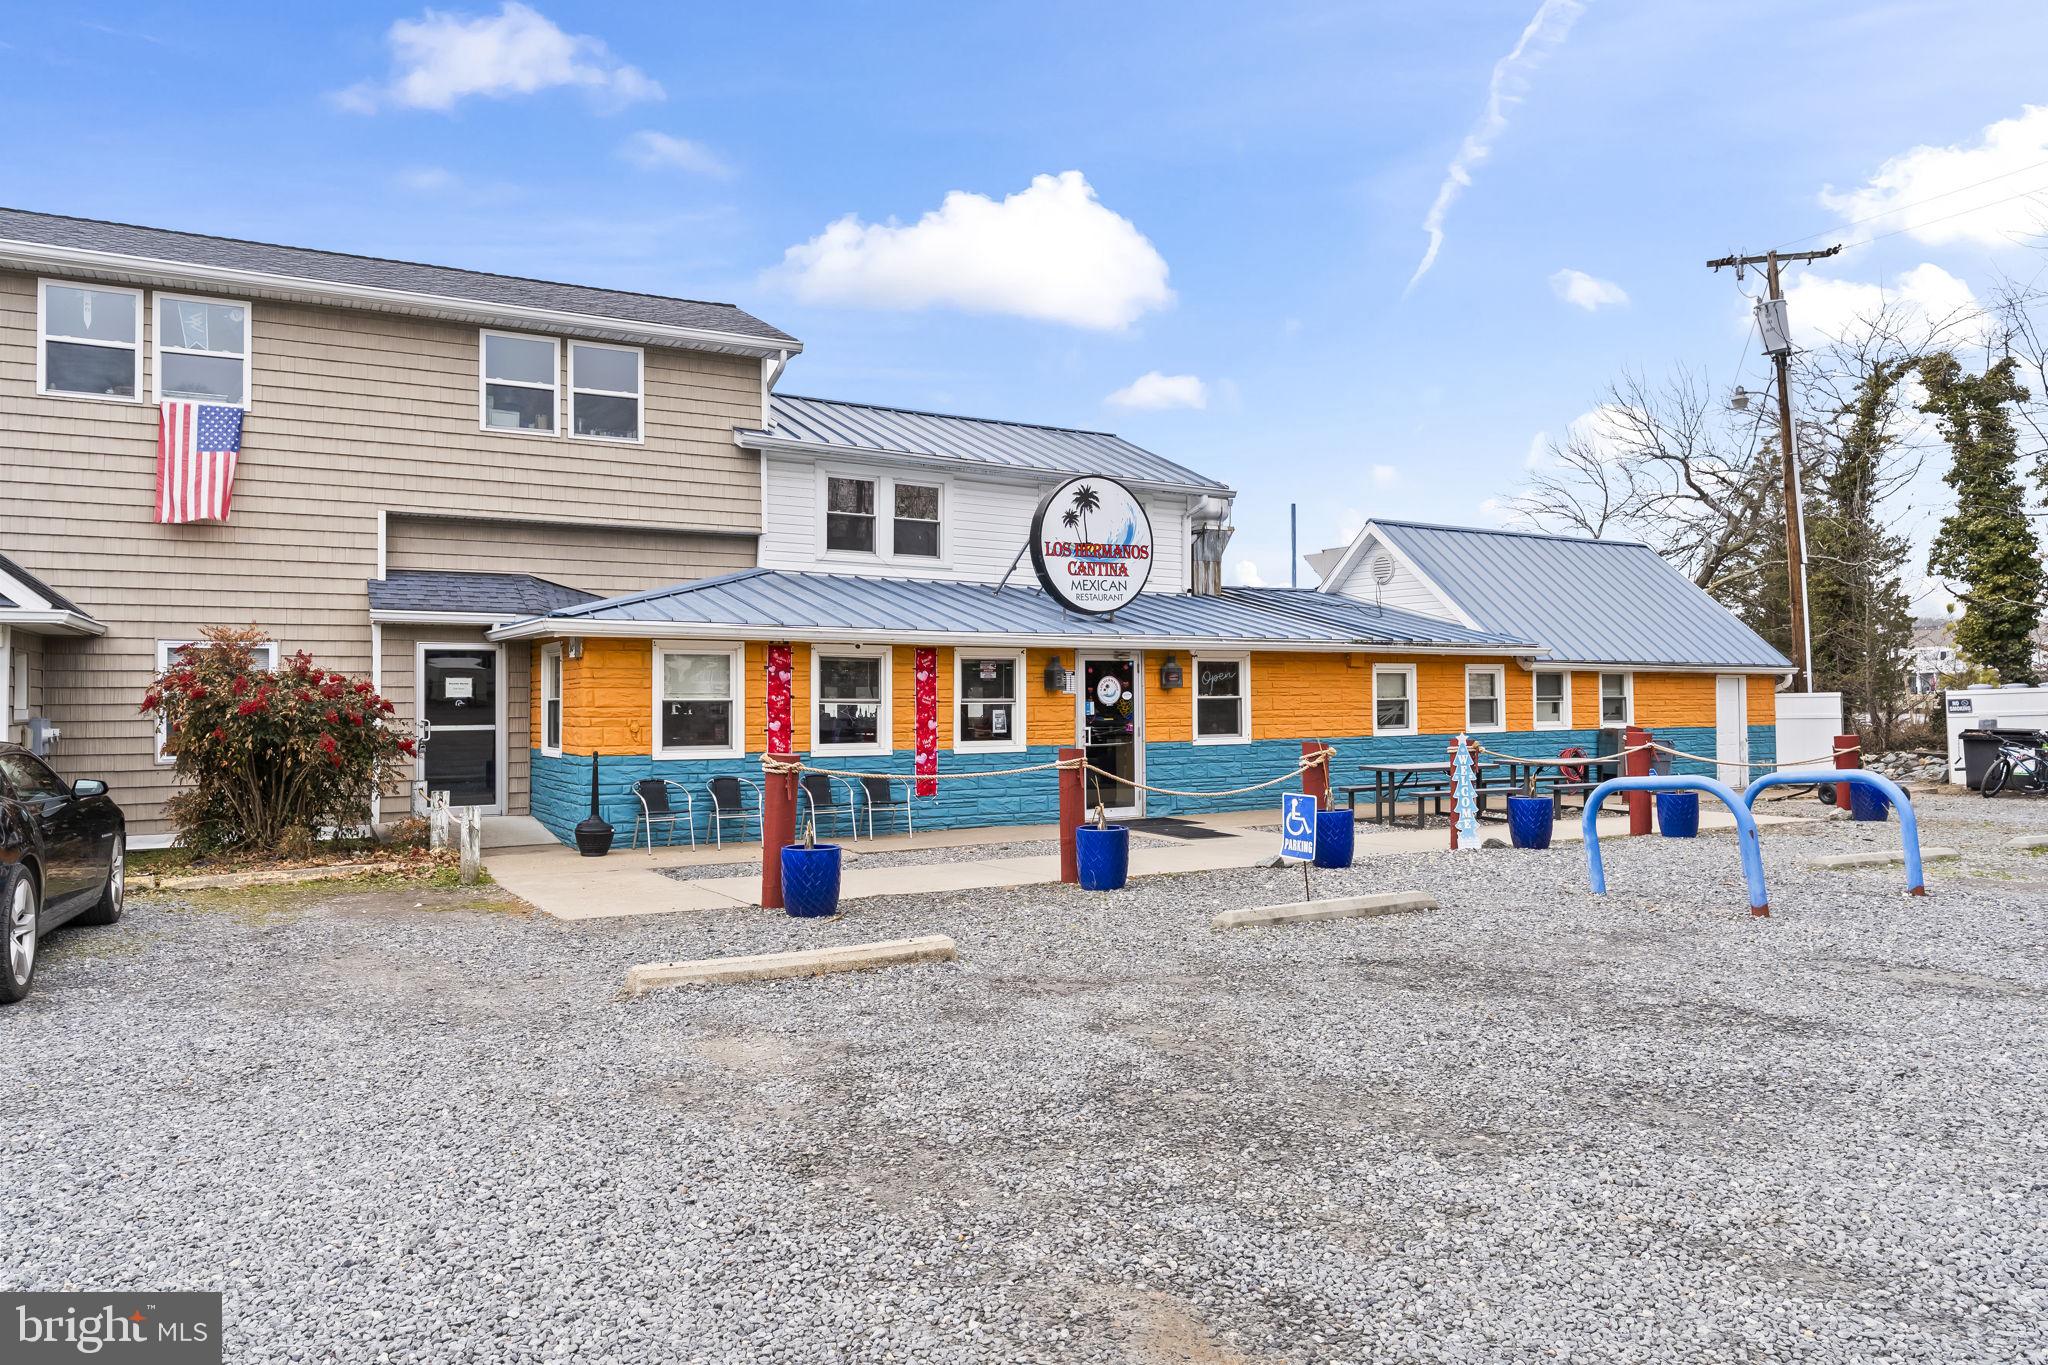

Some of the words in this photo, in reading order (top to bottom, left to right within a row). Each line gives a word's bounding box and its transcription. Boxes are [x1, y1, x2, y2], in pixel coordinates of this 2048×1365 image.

[1045, 541, 1072, 557] LOS
[1074, 542, 1150, 560] HERMANOS
[1067, 561, 1129, 577] CANTINA
[1070, 579, 1127, 592] MEXICAN
[1075, 593, 1123, 602] RESTAURANT
[1202, 671, 1236, 695] Open
[1458, 754, 1472, 829] WELCOME
[1284, 838, 1313, 853] PARKING
